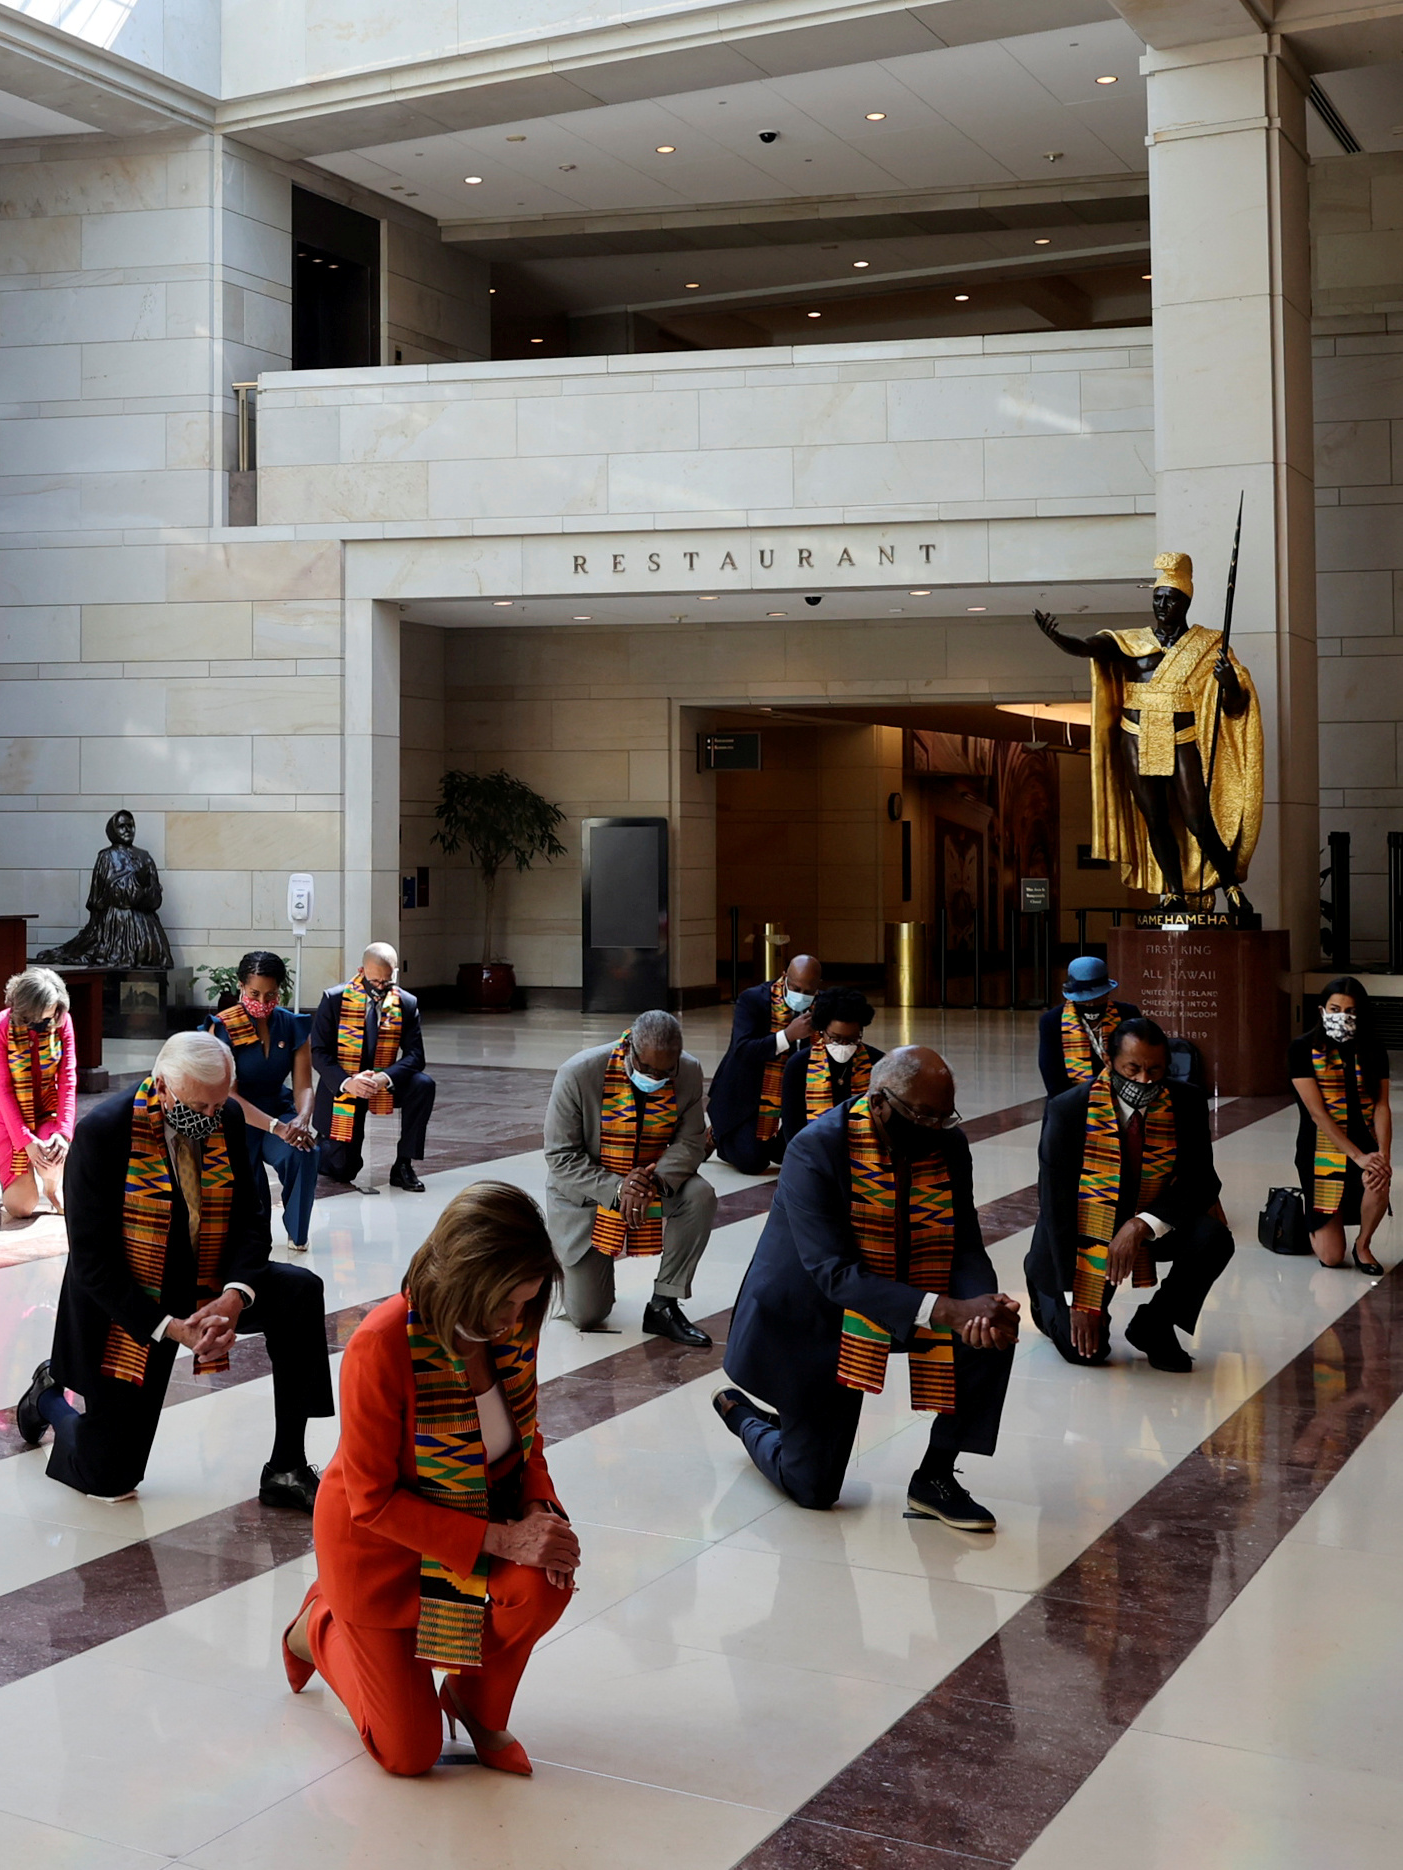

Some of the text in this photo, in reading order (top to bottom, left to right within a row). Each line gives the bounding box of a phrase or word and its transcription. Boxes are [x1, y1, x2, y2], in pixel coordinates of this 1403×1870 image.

[572, 543, 937, 575] RESTAURANT
[1137, 914, 1229, 926] KAMEHAMEHA
[1146, 945, 1212, 955] FIRST KING
[1172, 958, 1184, 966] OF
[1142, 969, 1216, 980] ALL HAWAII
[1170, 989, 1185, 997] THE
[1142, 1009, 1218, 1018] PEACEFUL KINGDOM
